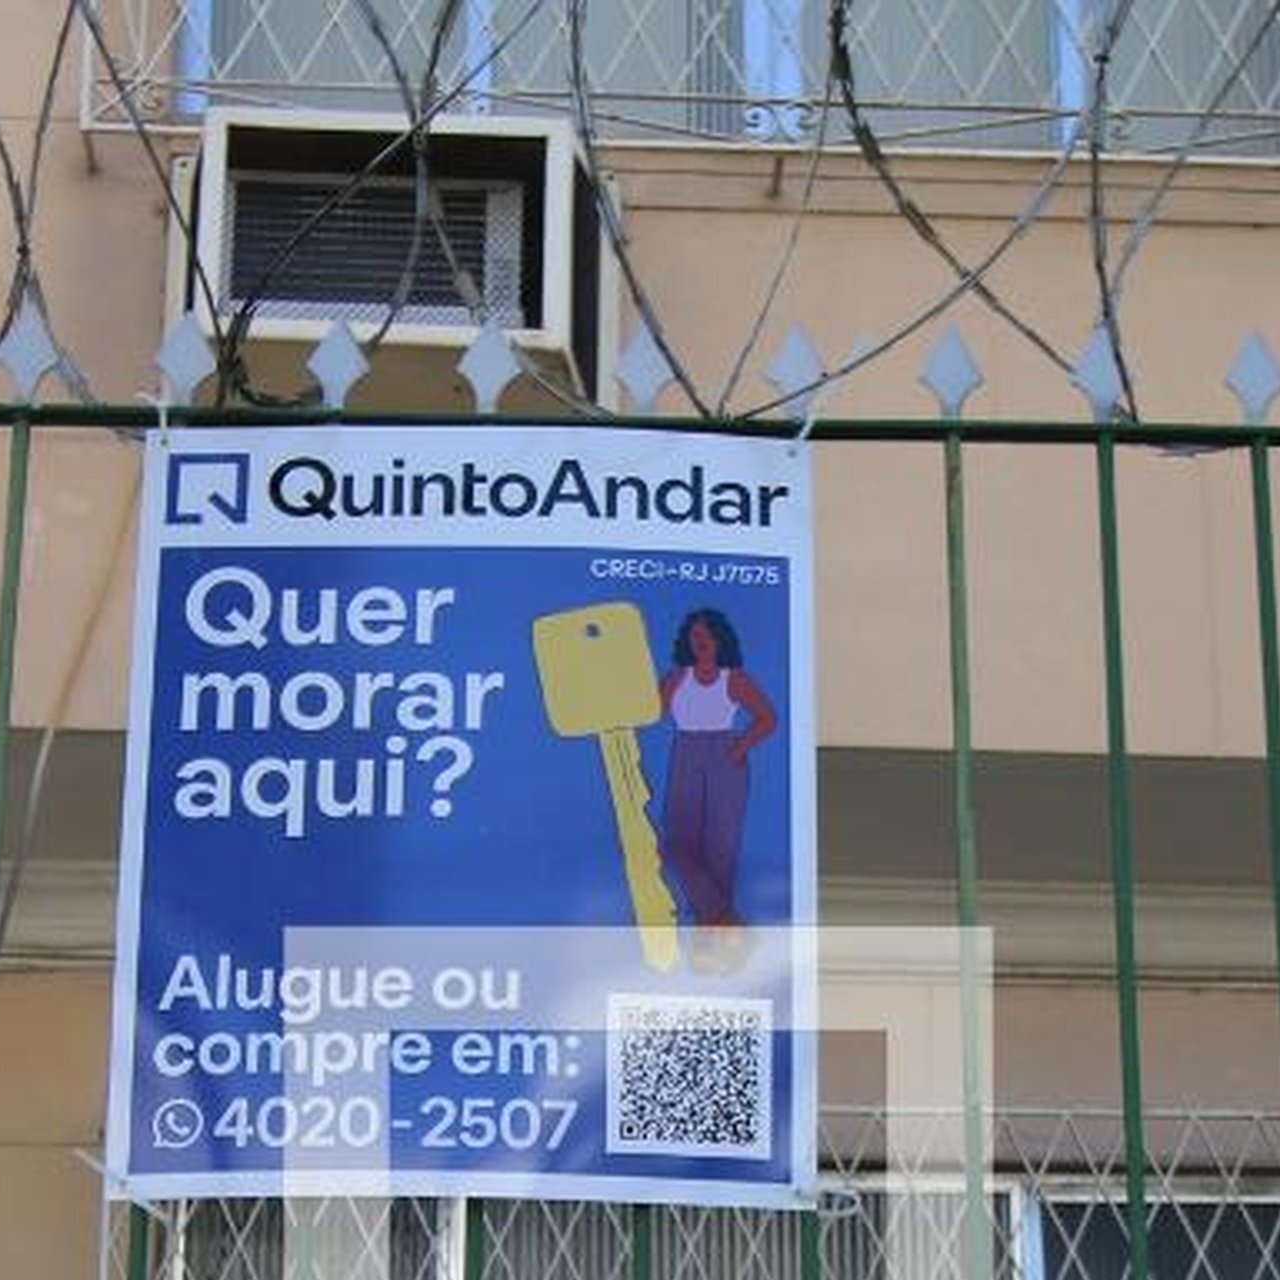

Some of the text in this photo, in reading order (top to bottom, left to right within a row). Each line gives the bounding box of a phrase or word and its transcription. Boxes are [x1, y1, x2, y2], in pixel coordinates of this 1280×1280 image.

[269, 456, 789, 527] QuintoAndar
[185, 567, 455, 649] Quer
[179, 671, 505, 731] morar
[173, 737, 475, 837] aqui?
[158, 955, 521, 1022] Alugue ou
[153, 1030, 582, 1086] compre em:
[213, 1098, 579, 1149] 4020-2507
